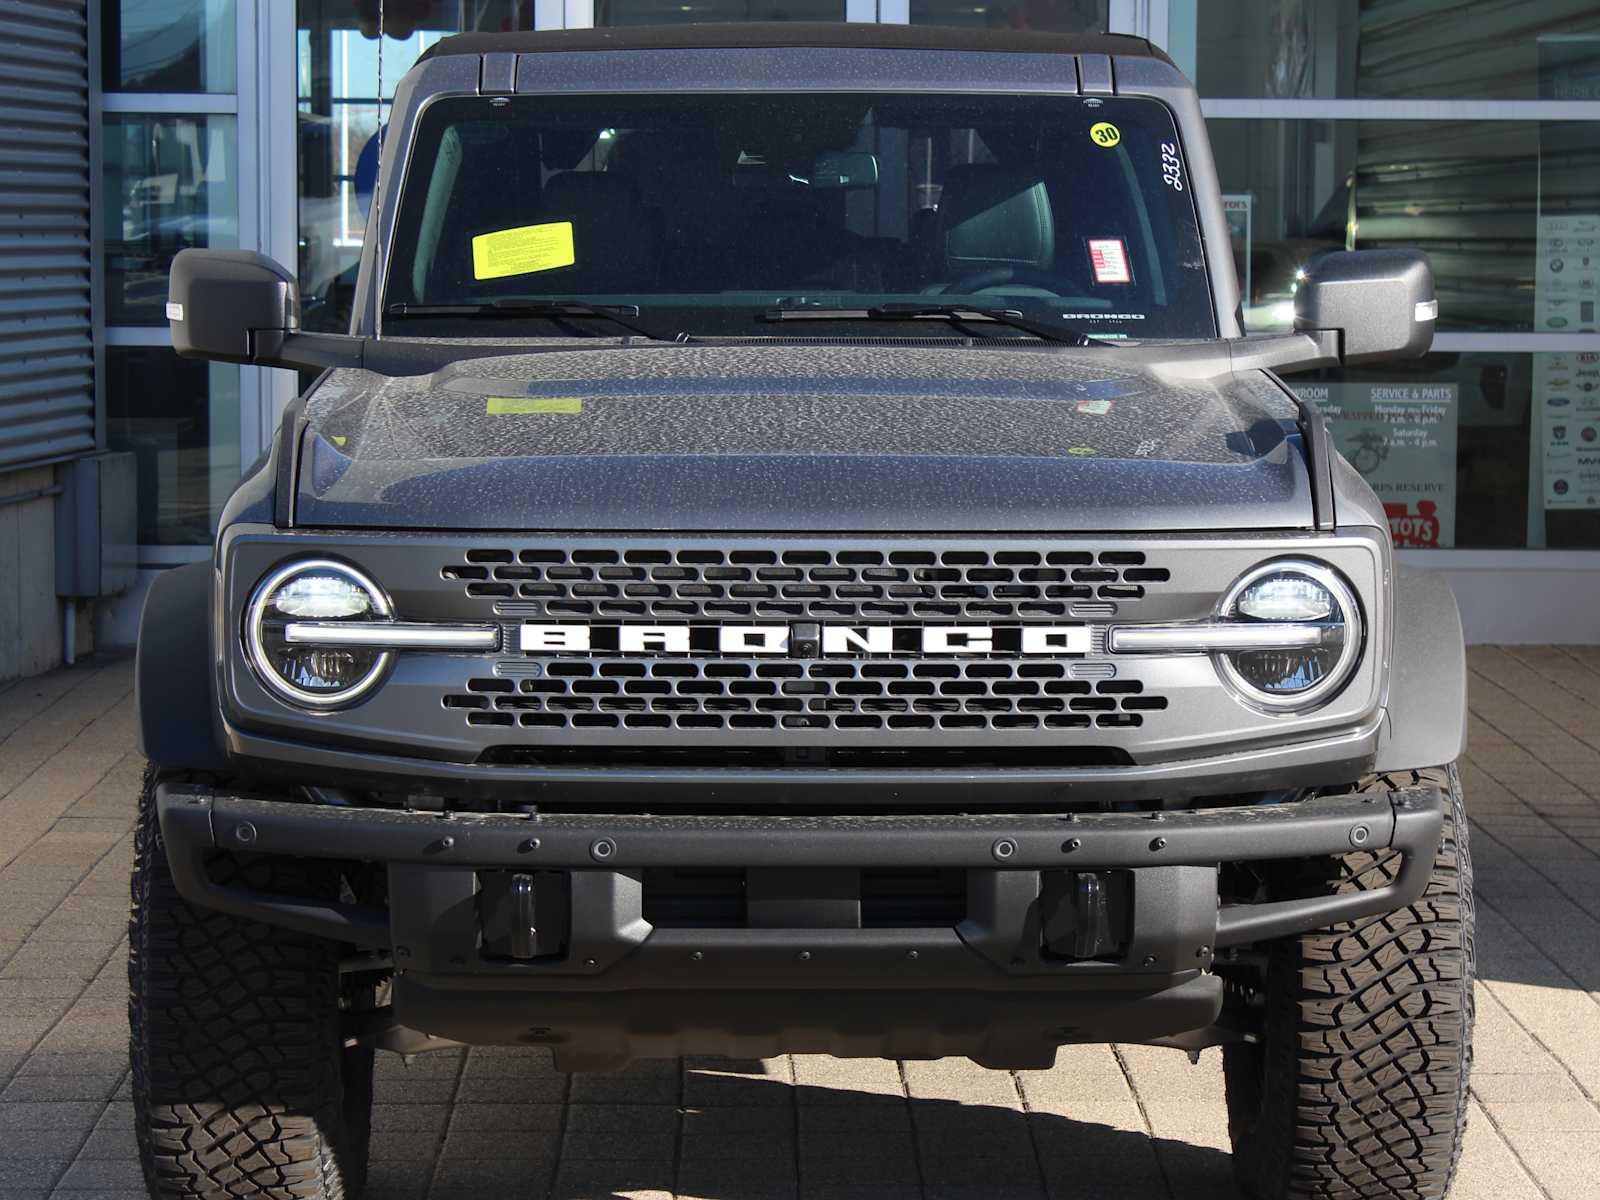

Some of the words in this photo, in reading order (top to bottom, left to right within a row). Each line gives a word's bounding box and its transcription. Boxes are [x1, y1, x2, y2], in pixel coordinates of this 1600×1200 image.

[1095, 127, 1118, 143] 30
[1161, 142, 1183, 191] 2332
[1370, 388, 1408, 399] SERVICE
[1411, 388, 1419, 399] &
[1422, 388, 1452, 399] PARTS
[1375, 405, 1405, 414] Monday
[1422, 404, 1446, 415] Friday
[1393, 428, 1428, 437] Saturday
[1392, 483, 1444, 492] RESERVE
[1390, 517, 1433, 542] TOYS
[520, 624, 1092, 652] BRONCO
